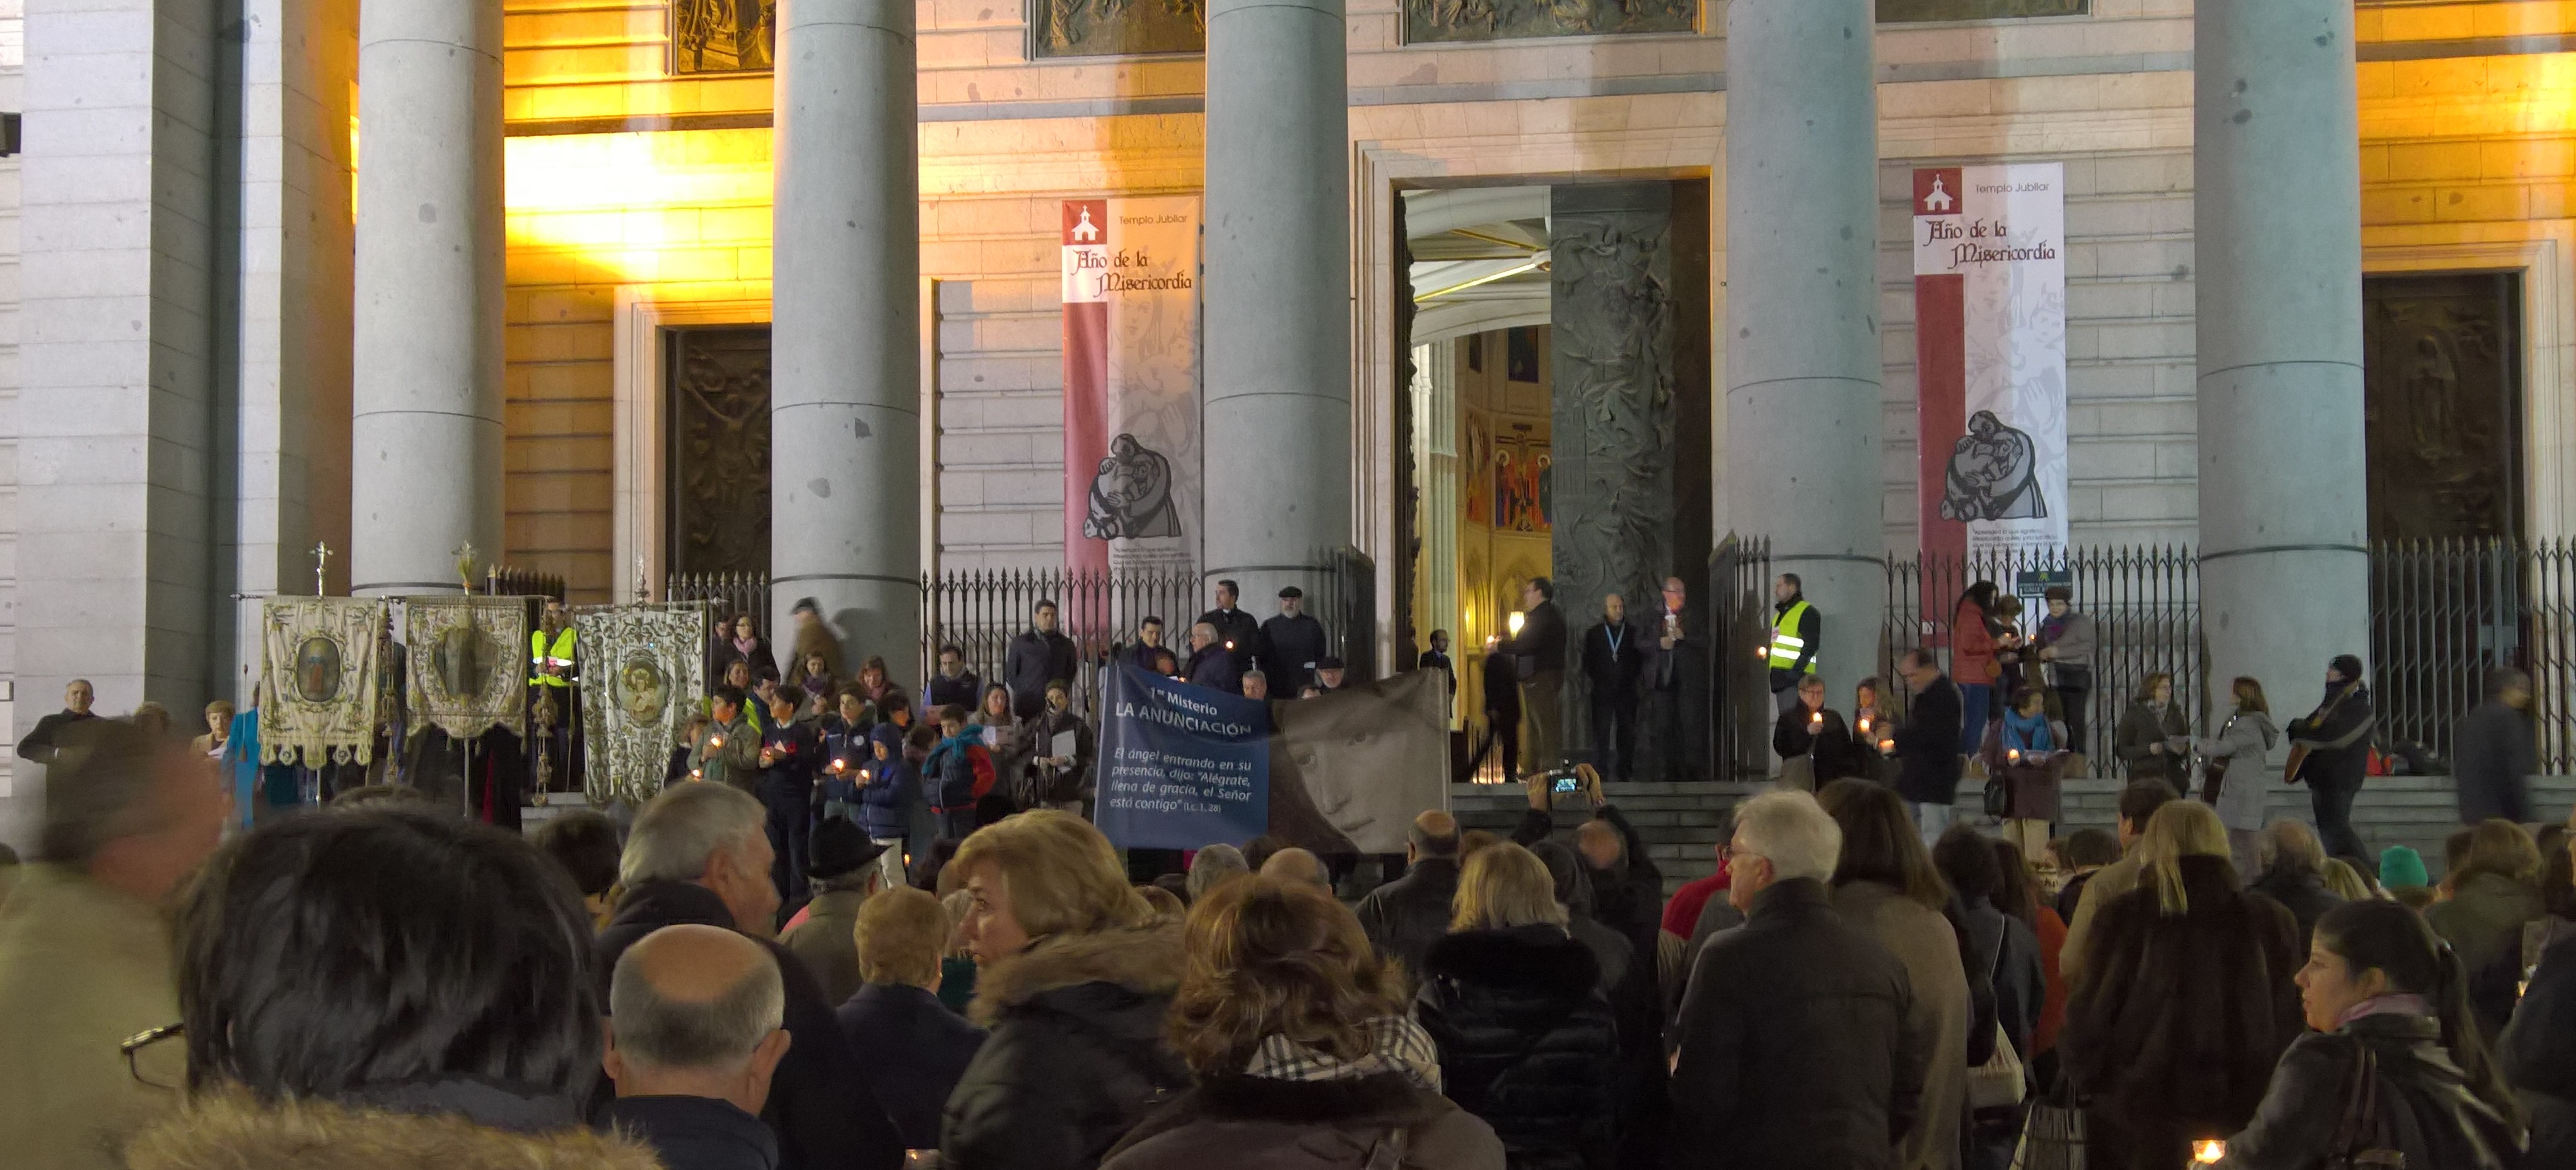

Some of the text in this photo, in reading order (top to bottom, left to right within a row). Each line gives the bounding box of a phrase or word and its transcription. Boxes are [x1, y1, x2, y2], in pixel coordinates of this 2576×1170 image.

[1976, 182, 2049, 194] Templo Jubilar
[1119, 214, 1187, 226] Templo Jubilar
[1923, 218, 2007, 246] Año de la
[1070, 248, 1148, 275] Año de la
[1947, 240, 2056, 270] Misericordia
[1093, 269, 1192, 298] Misericordia
[1168, 692, 1218, 716] Misterio
[1116, 702, 1252, 738] LA ANUNCIACIÓN
[1114, 747, 1252, 772] El ángel entrando en su
[1111, 765, 1165, 779] presencia,
[1109, 797, 1133, 808] está
[1110, 780, 1252, 802] llena de gracia, el Señor
